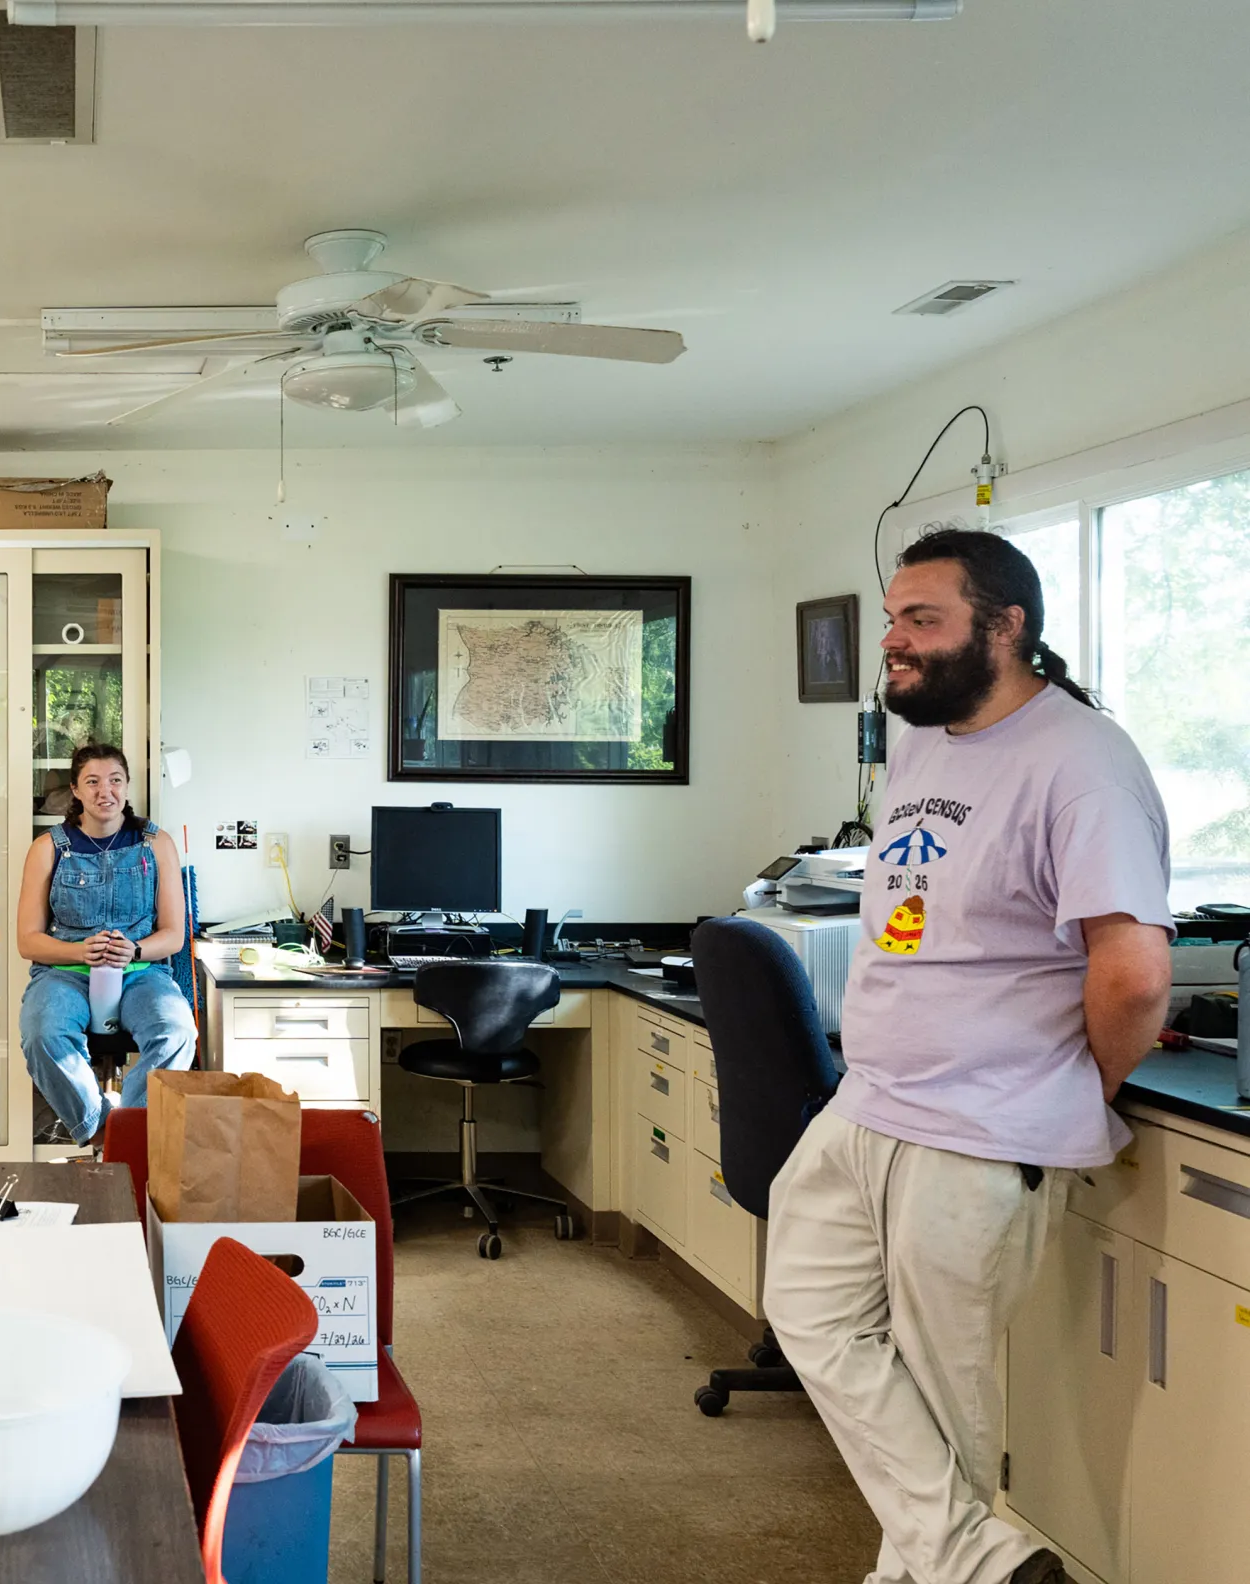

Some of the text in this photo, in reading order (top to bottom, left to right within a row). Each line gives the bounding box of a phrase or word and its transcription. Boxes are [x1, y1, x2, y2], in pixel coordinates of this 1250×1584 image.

[925, 798, 973, 826] CENSUS
[887, 874, 903, 891] 20
[342, 1294, 357, 1312] N
